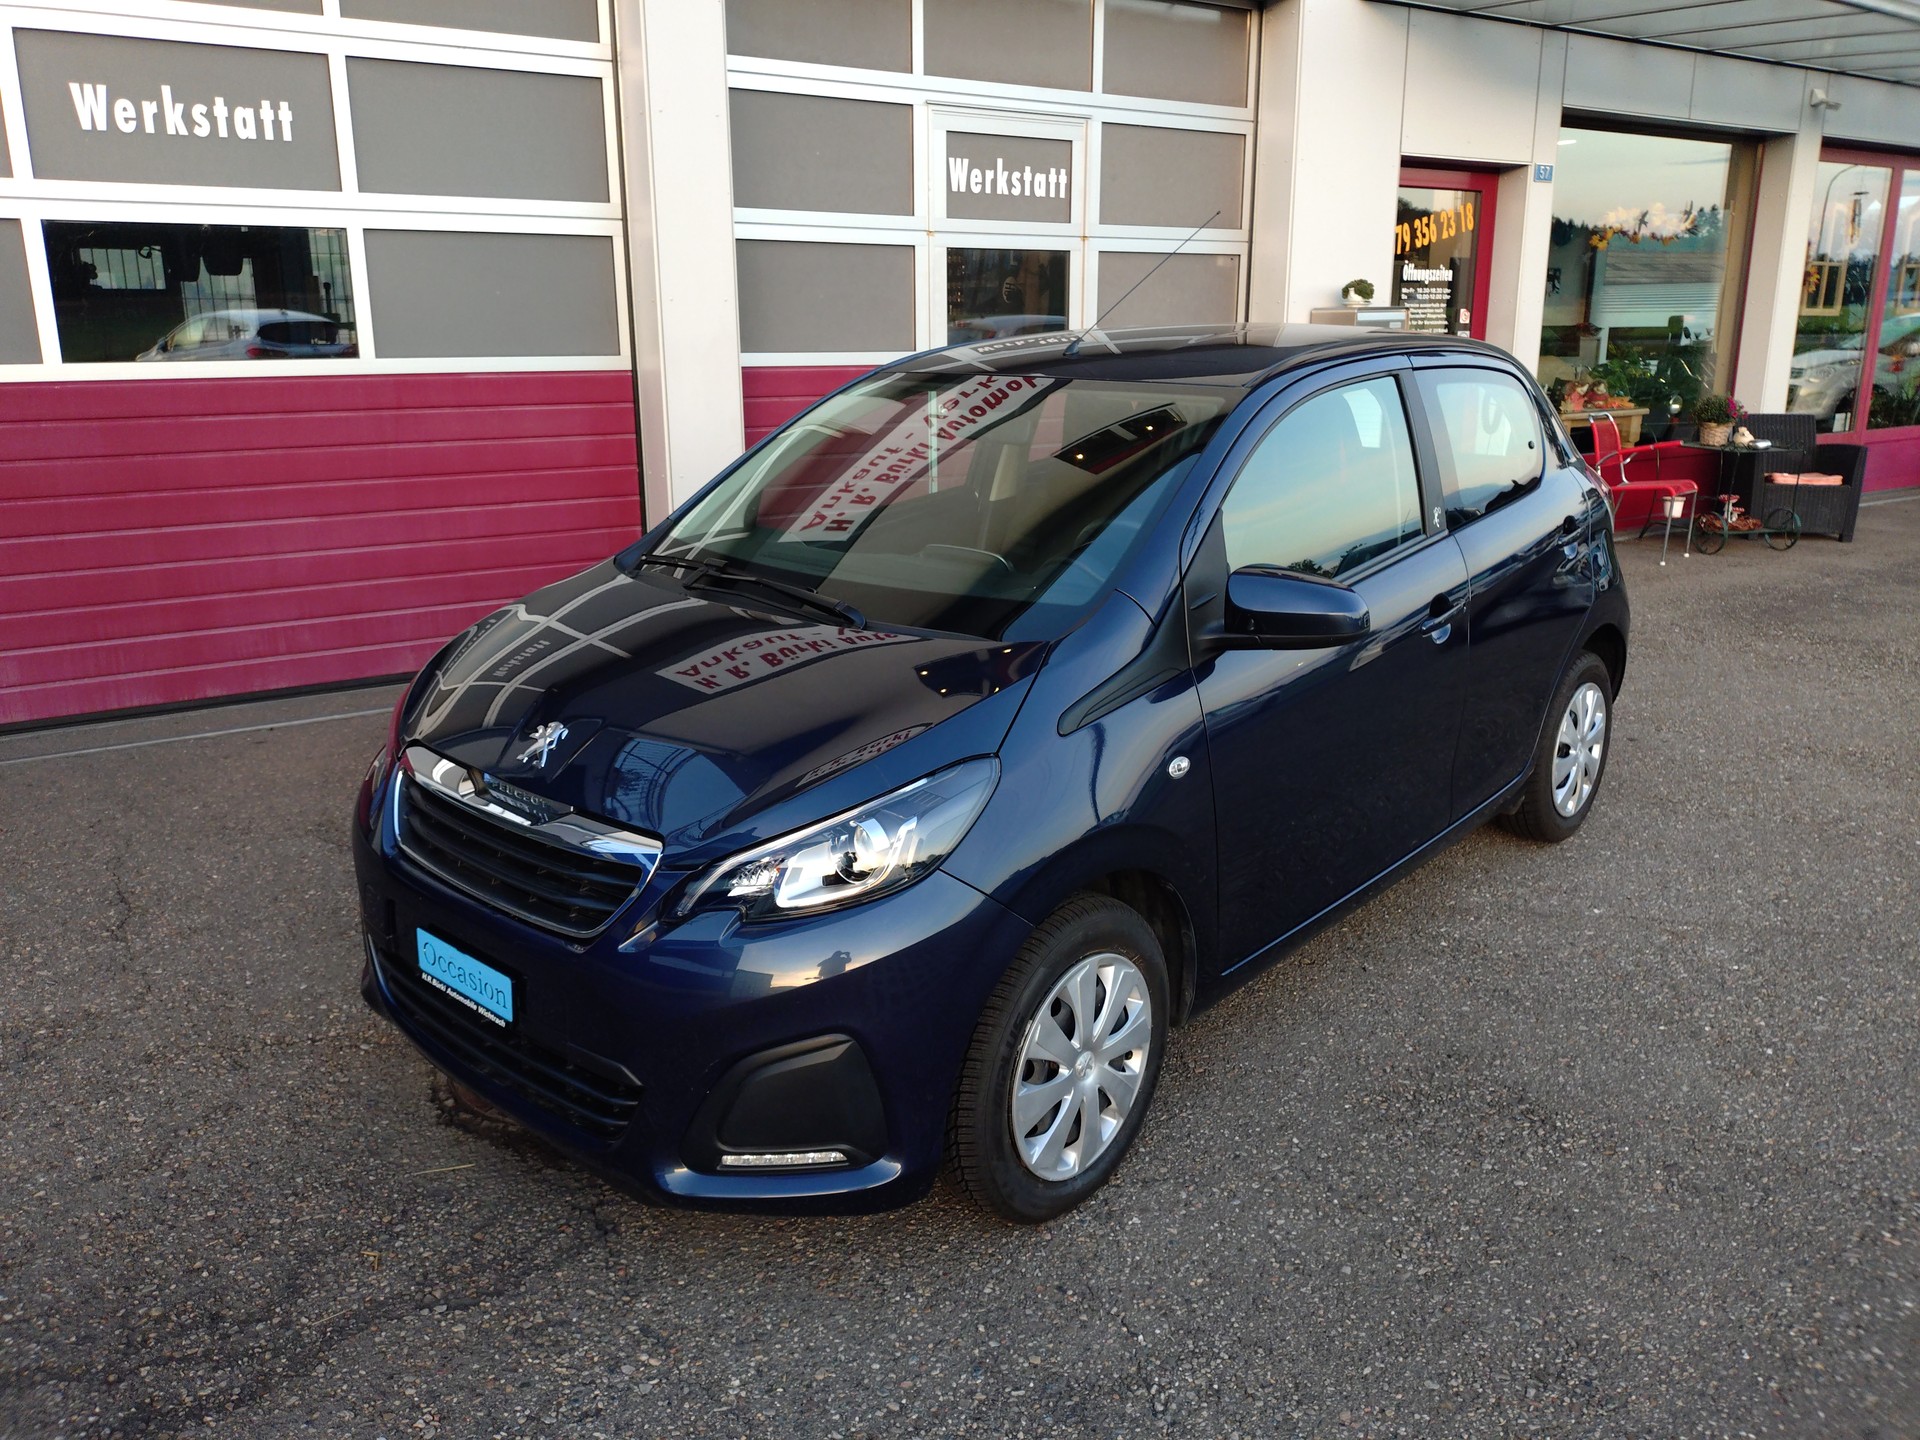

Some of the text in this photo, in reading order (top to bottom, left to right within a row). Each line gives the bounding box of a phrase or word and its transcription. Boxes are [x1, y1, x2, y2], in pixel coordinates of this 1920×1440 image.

[68, 82, 293, 142] Werkstatt
[948, 157, 1068, 199] Werkstatt
[1539, 165, 1550, 180] 57
[1414, 214, 1437, 249] 356
[1440, 208, 1456, 239] 23
[1460, 202, 1474, 232] 18
[1402, 259, 1453, 285] Öffnungszeiten
[423, 942, 508, 1009] Occasion
[446, 987, 478, 1011] Automobile
